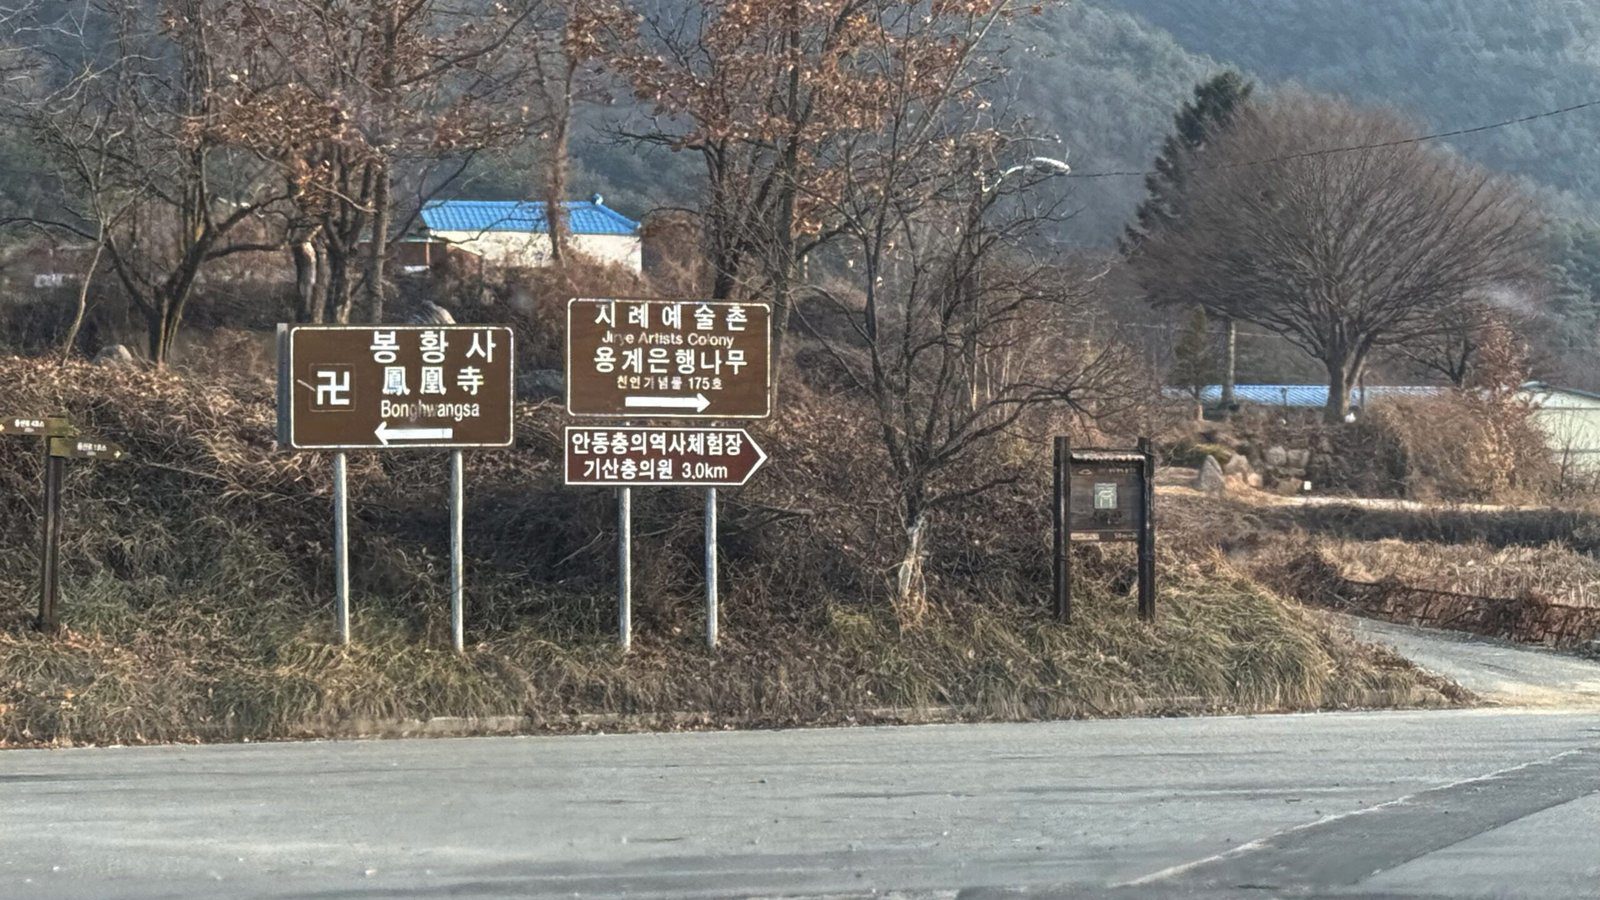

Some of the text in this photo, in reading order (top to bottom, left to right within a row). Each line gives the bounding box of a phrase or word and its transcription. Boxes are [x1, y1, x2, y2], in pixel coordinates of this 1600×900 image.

[370, 330, 497, 363] 봉황사
[638, 332, 683, 345] Artists
[687, 333, 735, 348] Colony
[593, 346, 748, 375] 용계은행나무
[382, 365, 484, 396] 鳳凰寺
[688, 377, 723, 391] 175호
[380, 399, 480, 422] Bonghwangsa
[571, 431, 743, 456] 안동충의역사체험장
[583, 457, 728, 481] 기산충의원 3.0km
